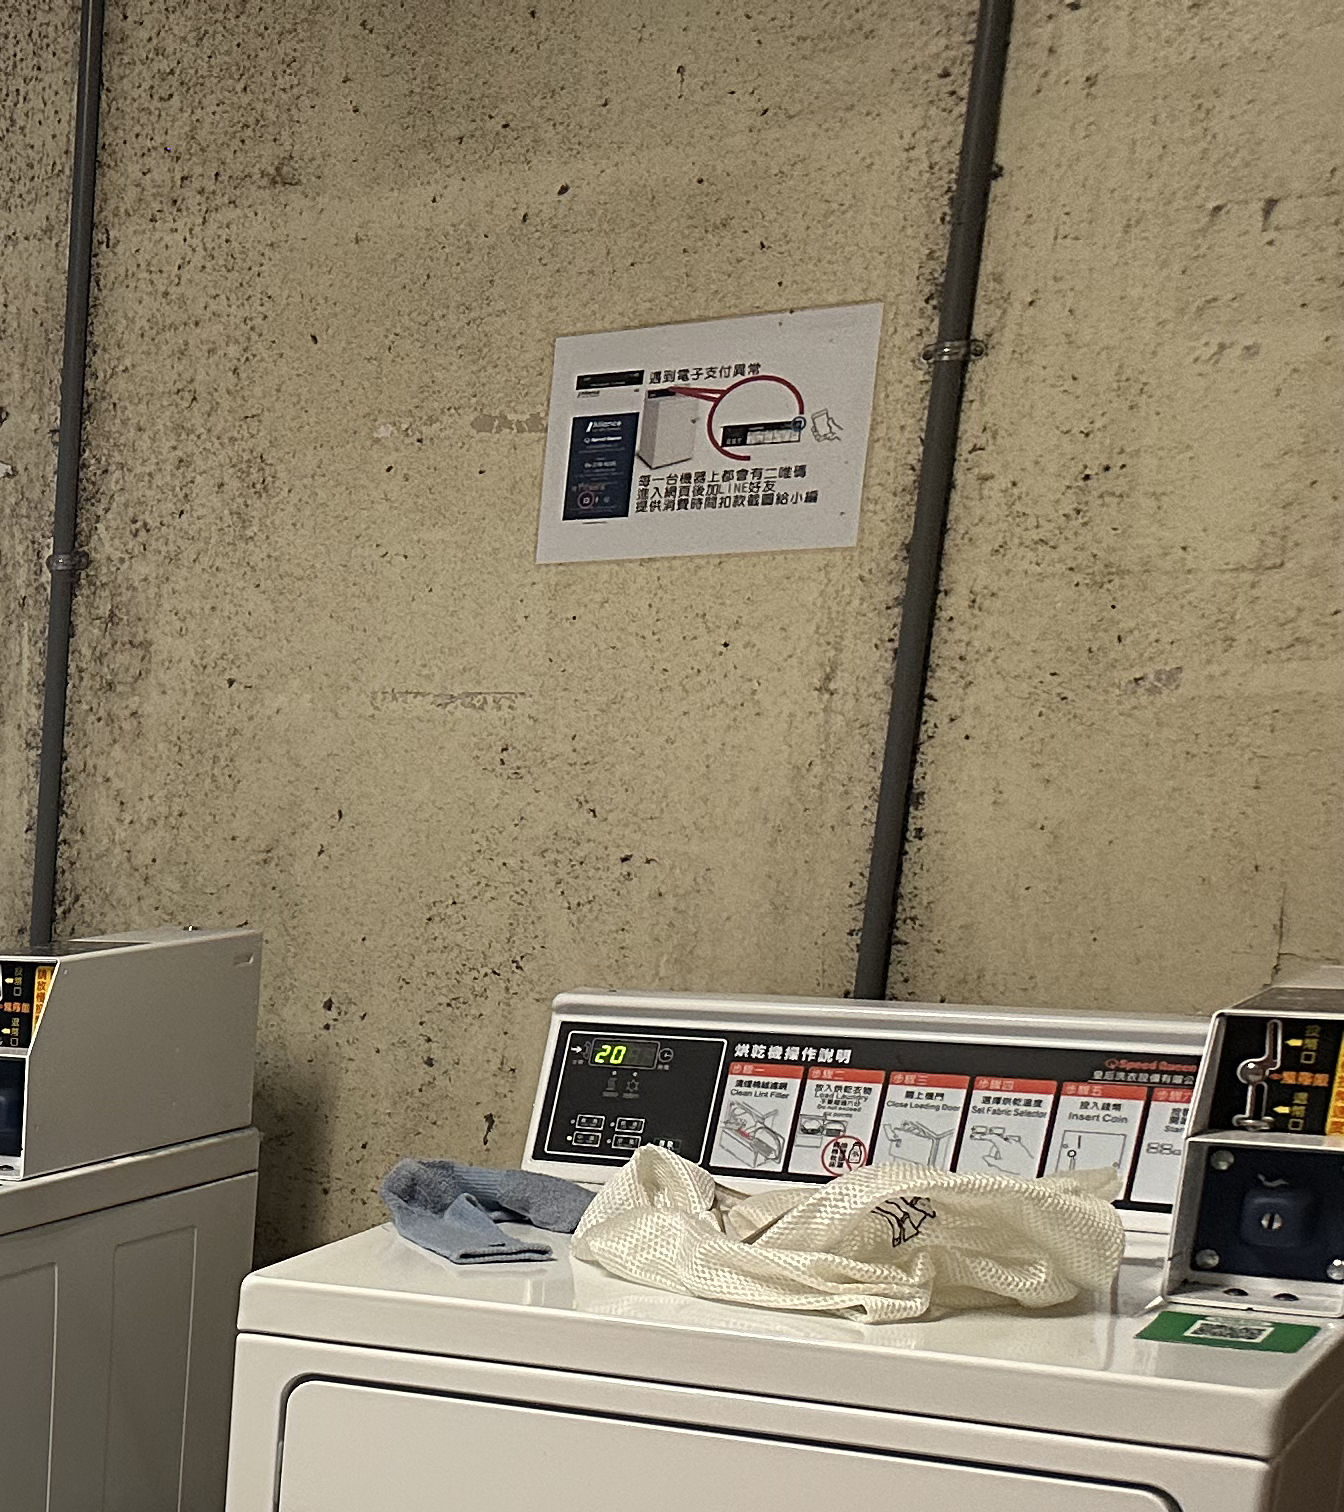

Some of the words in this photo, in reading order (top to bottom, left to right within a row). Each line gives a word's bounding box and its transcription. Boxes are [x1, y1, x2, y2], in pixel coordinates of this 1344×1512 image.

[649, 363, 761, 384] 遇到電子支付異常
[594, 1044, 627, 1064] 20
[734, 1043, 852, 1064] 烘乾機操作說明
[730, 1089, 753, 1097] Clean
[887, 1100, 908, 1108] Close
[910, 1102, 940, 1111] Loading
[1068, 1112, 1100, 1122] Insert
[1102, 1114, 1128, 1124] Coin
